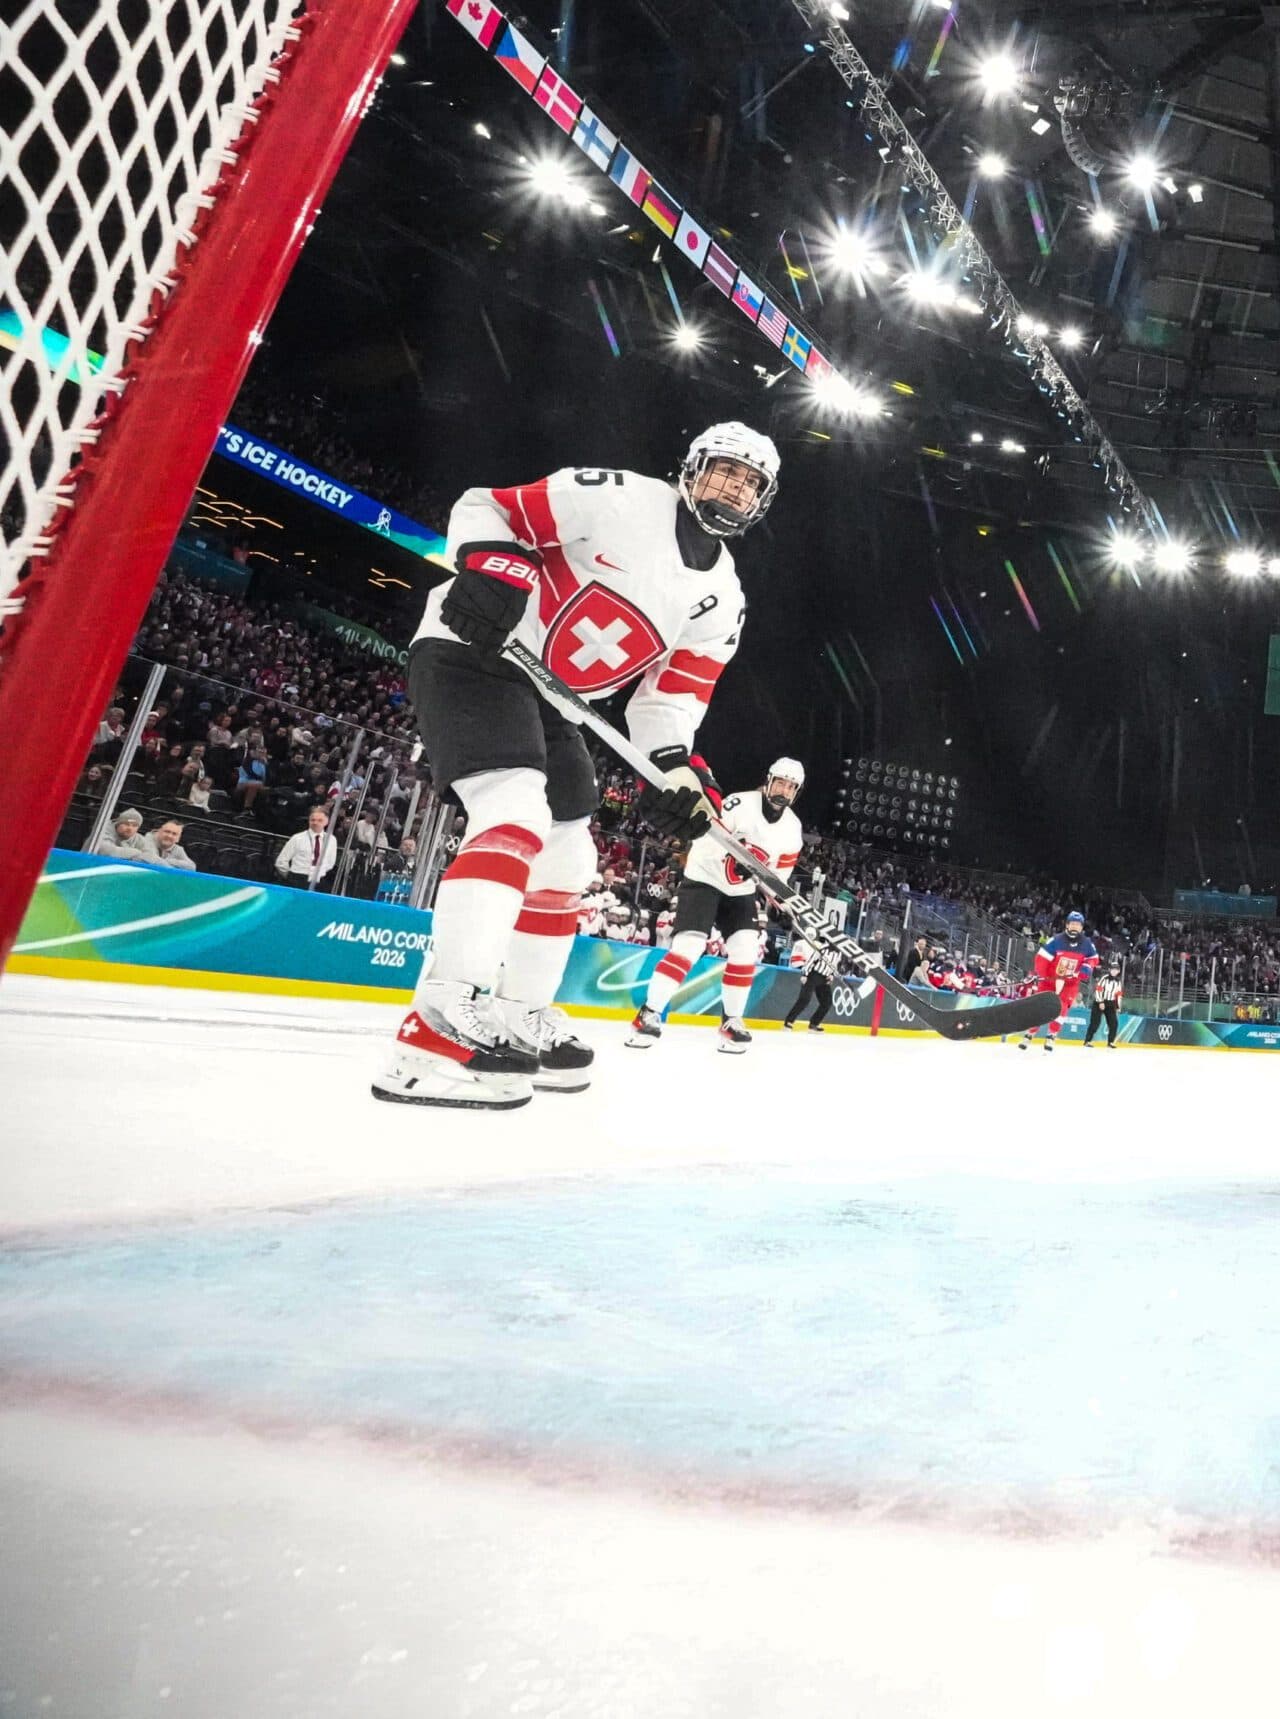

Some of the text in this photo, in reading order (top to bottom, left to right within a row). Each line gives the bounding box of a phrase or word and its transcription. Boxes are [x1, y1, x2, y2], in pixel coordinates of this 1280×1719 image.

[243, 440, 277, 471] ICE
[275, 459, 353, 510] HOCKEY
[317, 921, 434, 951] MILANO CORT
[370, 947, 406, 967] 2026
